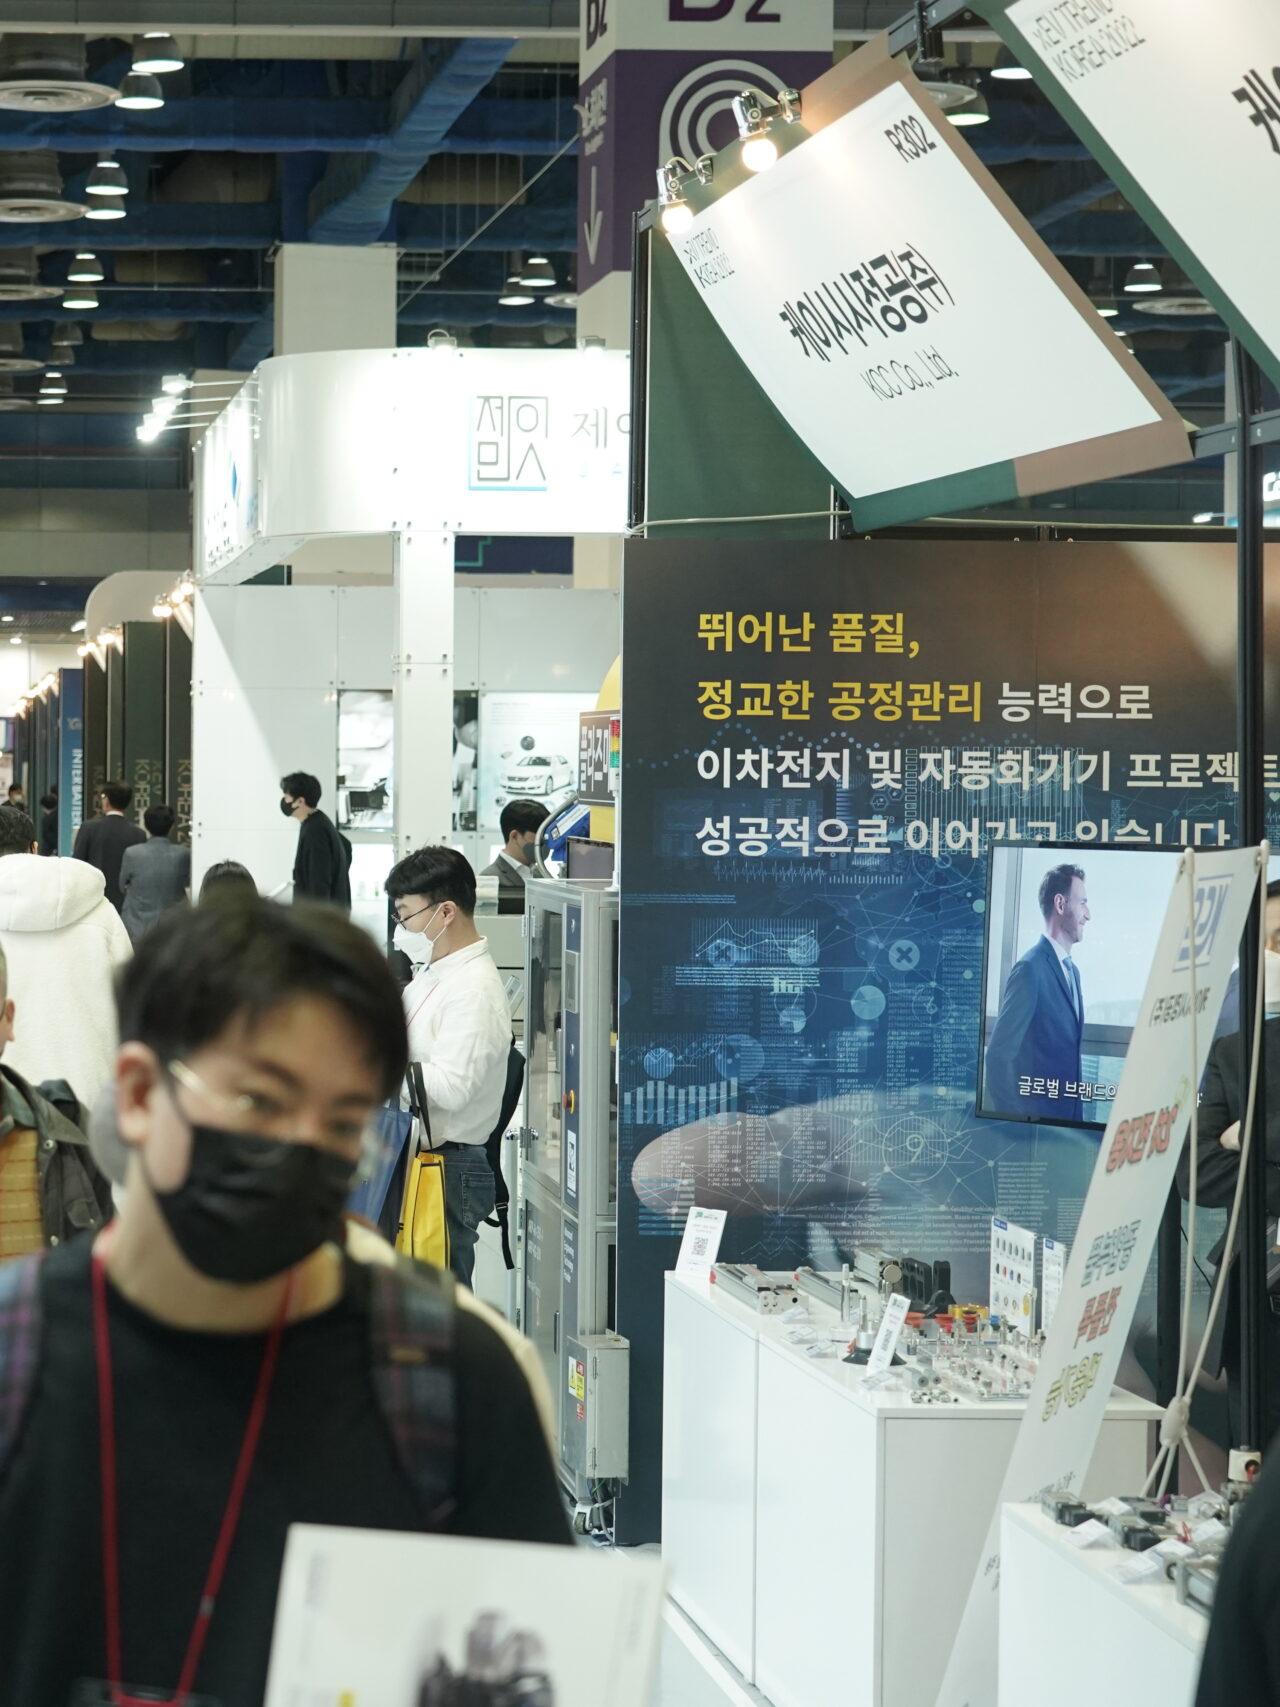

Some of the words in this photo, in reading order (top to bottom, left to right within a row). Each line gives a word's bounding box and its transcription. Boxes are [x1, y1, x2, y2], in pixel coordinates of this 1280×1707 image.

[1231, 66, 1280, 156] 케
[883, 115, 937, 163] R302
[859, 364, 903, 401] KCC
[697, 611, 816, 653] 뛰어난
[829, 612, 920, 659] 품질,
[696, 679, 815, 721] 정교한
[828, 681, 981, 722] 공정관리
[997, 682, 1153, 723] 능력으로
[697, 747, 851, 789] 이차전지
[868, 748, 903, 790] 및
[917, 749, 1110, 792] 자동화기기
[695, 815, 892, 858] 성공적으로
[1018, 1076, 1060, 1099] 글로벌
